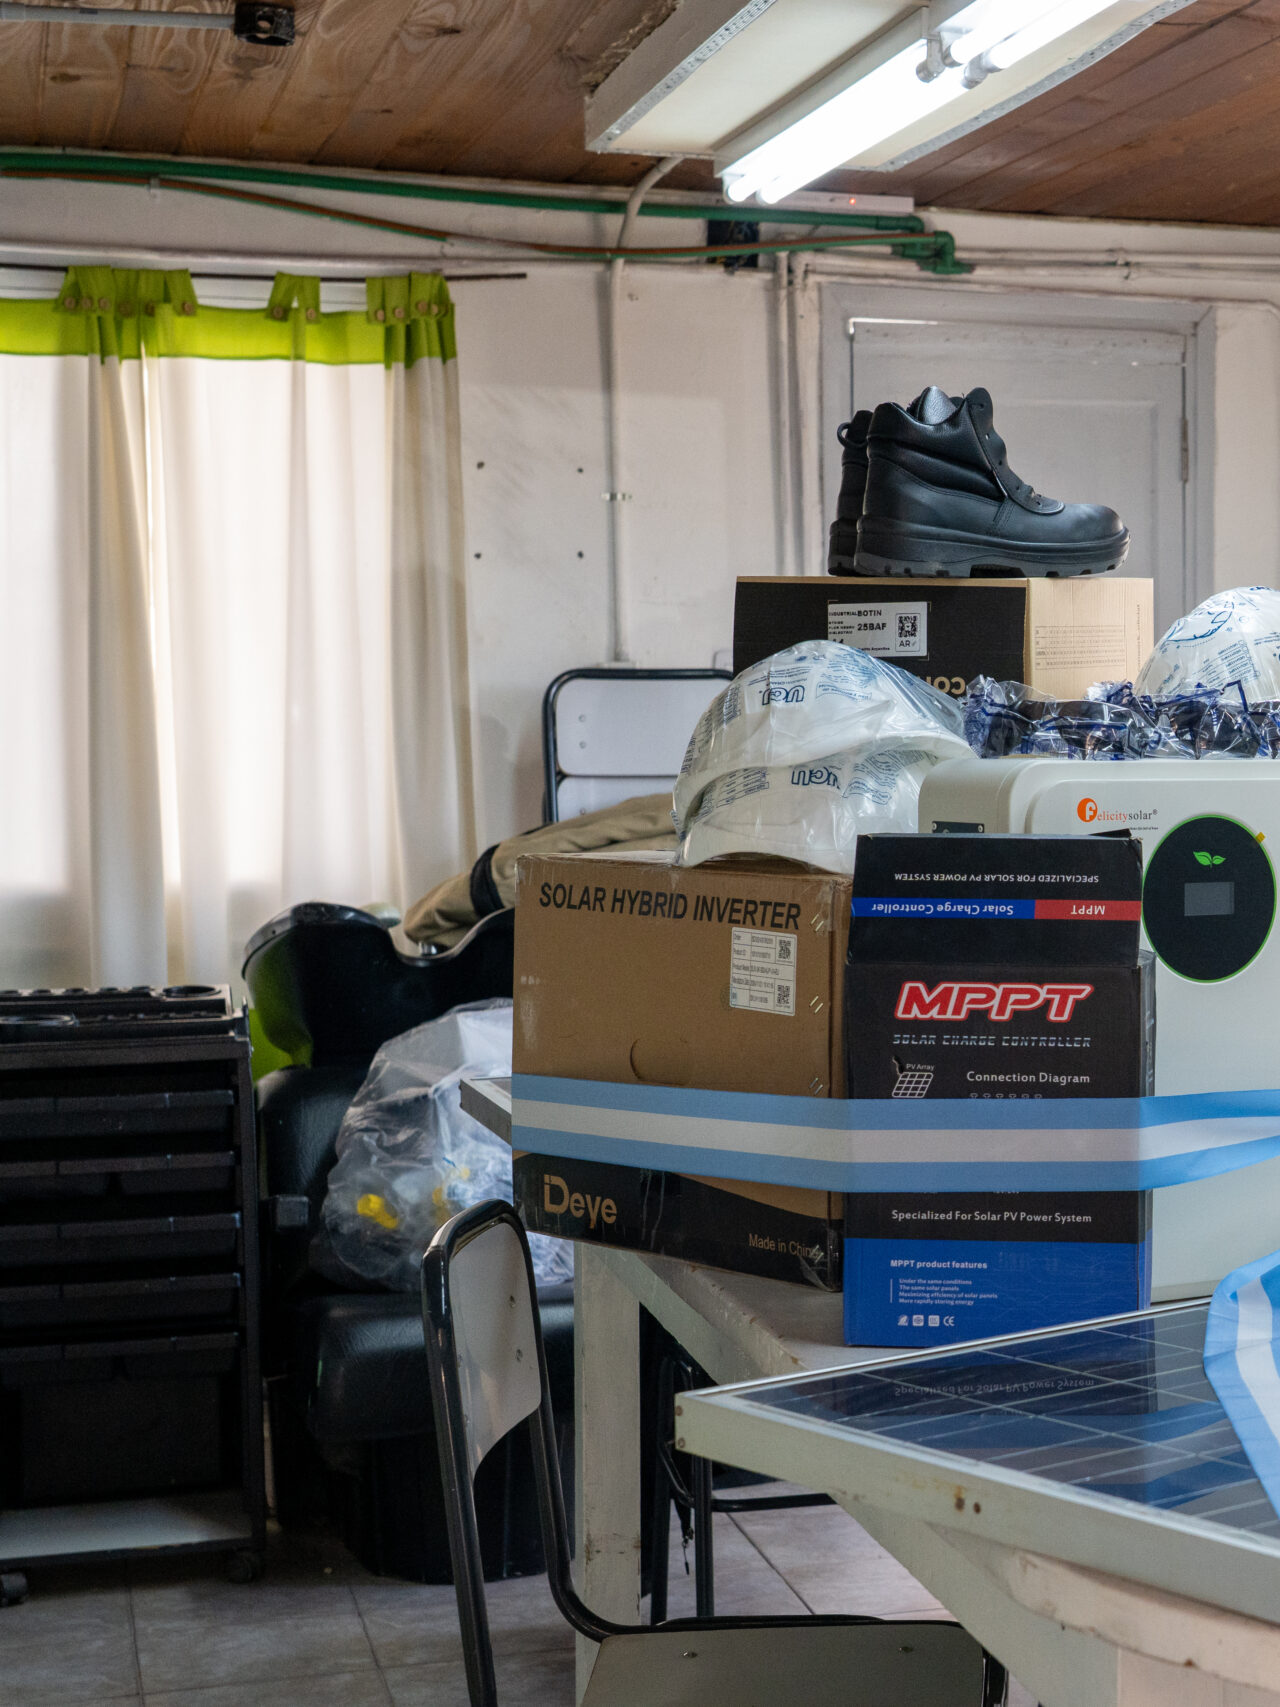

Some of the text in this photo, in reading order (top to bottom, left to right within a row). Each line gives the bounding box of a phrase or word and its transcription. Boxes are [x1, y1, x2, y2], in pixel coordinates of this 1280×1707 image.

[857, 609, 882, 617] BOTIN
[857, 622, 887, 631] 25BAF
[899, 640, 911, 648] AR
[917, 676, 966, 695] CO
[894, 873, 1099, 883] SPECIALIZED FOR SOLAR PV POWER SYSTEM
[539, 882, 801, 930] SOLAR HYBRID INVERTER
[871, 903, 1014, 916] Solar Charge Controller
[1070, 904, 1106, 915] MPPT
[894, 981, 1094, 1022] MPPT
[892, 1034, 1092, 1048] SOLAR CHARGE CONTROLLER
[918, 1063, 935, 1071] Array
[966, 1071, 1091, 1085] Connection Diagram
[544, 1173, 618, 1229] Deye
[891, 1209, 1092, 1224] Specialized For Solar PV Power System
[749, 1232, 776, 1251] Made
[777, 1238, 787, 1254] in
[890, 1259, 988, 1270] MPPT product features
